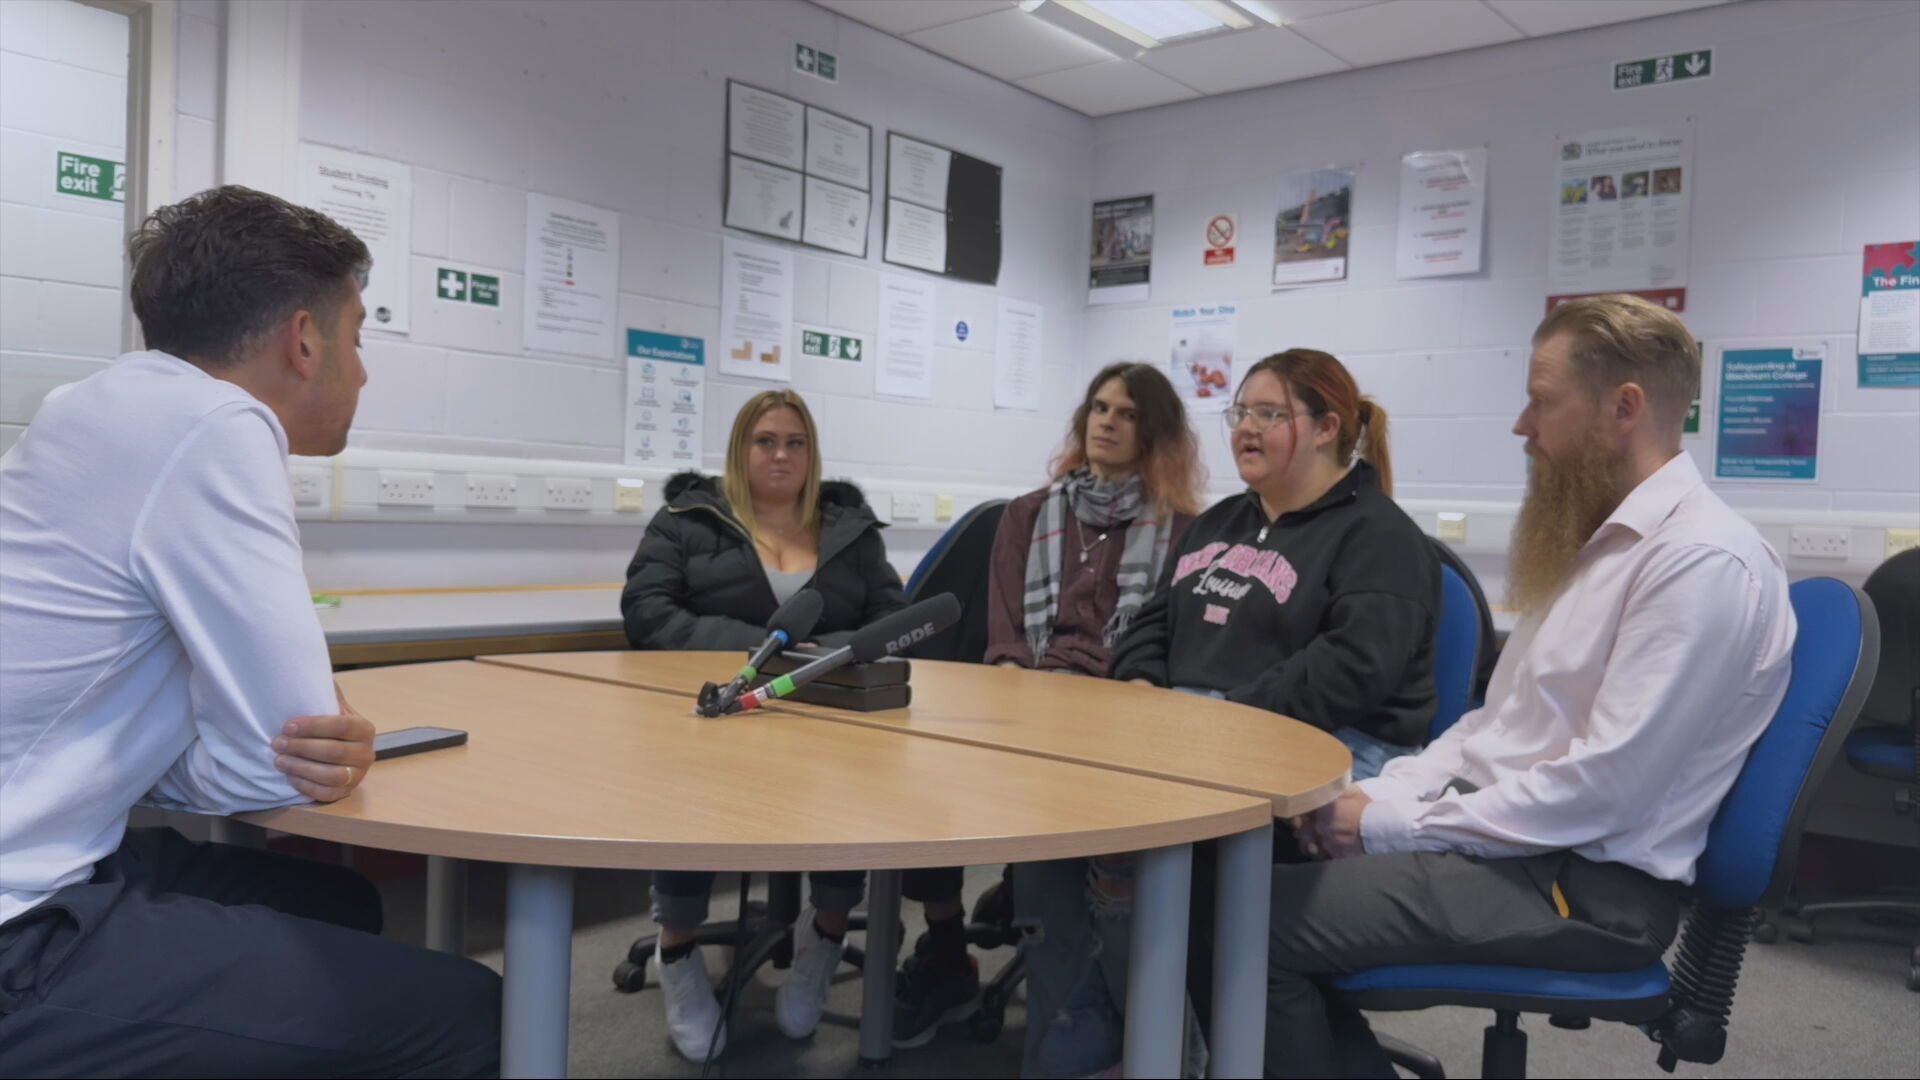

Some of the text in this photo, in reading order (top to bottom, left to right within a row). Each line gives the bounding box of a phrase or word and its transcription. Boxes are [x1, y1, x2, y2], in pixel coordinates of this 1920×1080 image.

[1618, 63, 1643, 78] Fire
[1618, 75, 1642, 88] exit
[61, 155, 101, 178] Fire
[61, 175, 99, 194] exit
[1872, 274, 1920, 289] The Fin
[805, 332, 823, 346] Fire
[637, 345, 652, 355] Our
[804, 344, 821, 355] exit
[1726, 361, 1797, 372] Safeguarding at
[1725, 371, 1808, 381] Blackburn College
[885, 621, 936, 654] RØDE
